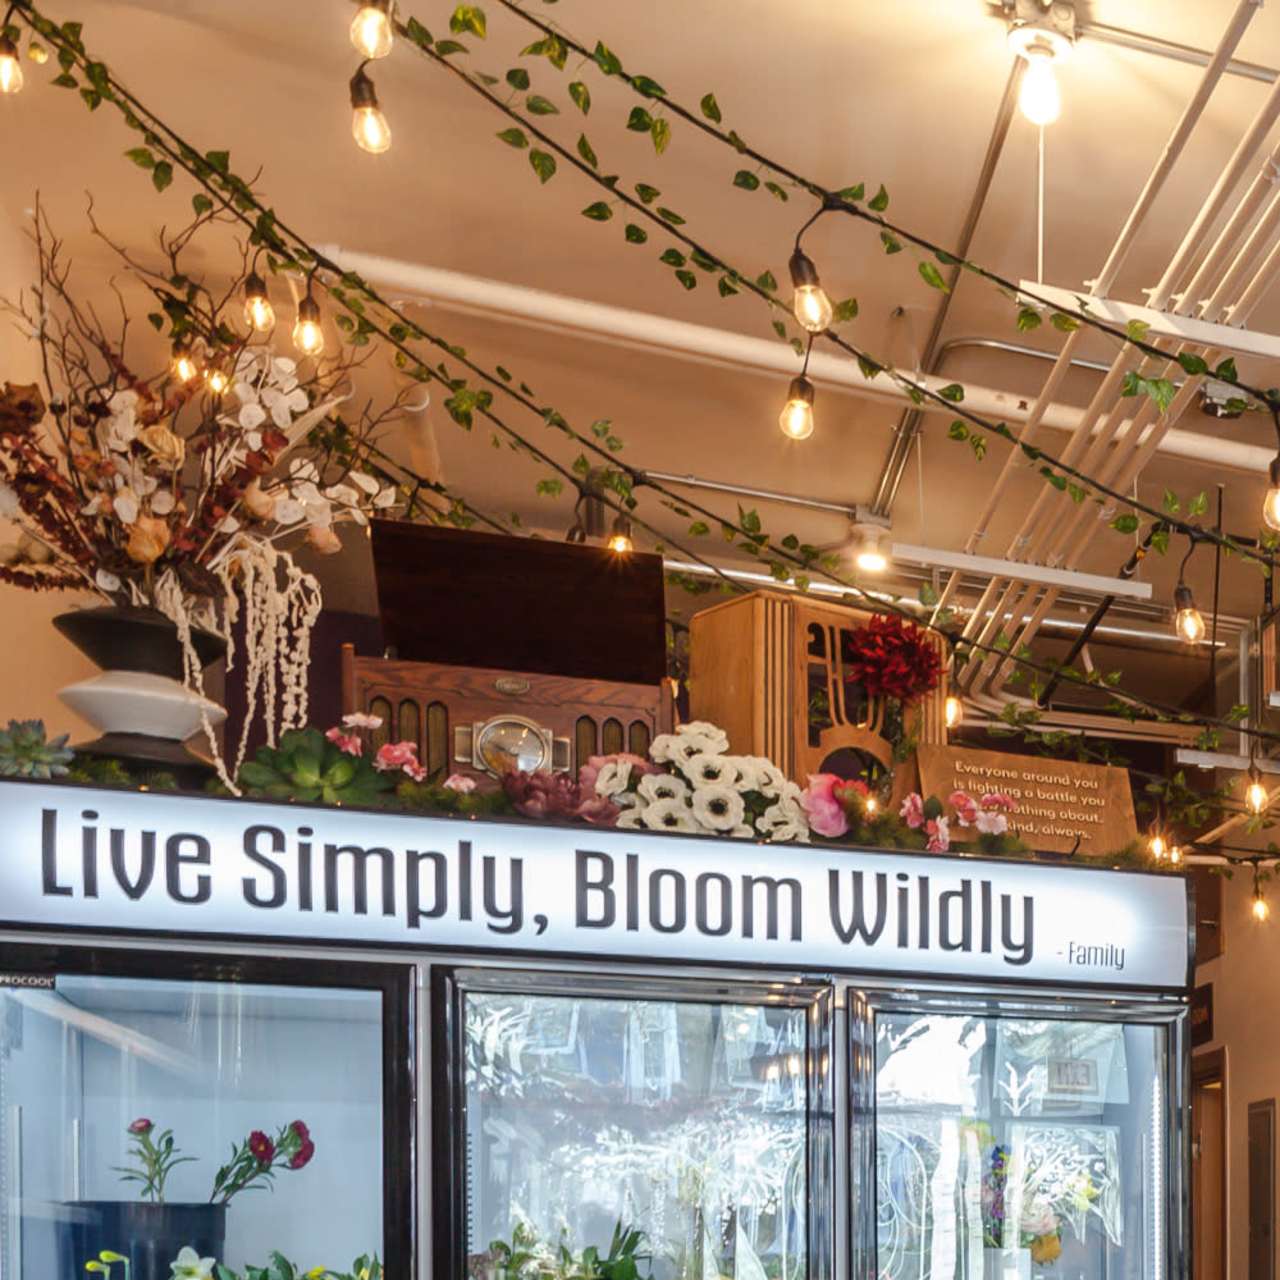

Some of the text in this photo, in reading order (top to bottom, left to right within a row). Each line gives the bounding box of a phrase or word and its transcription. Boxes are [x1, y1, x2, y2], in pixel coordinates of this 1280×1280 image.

[955, 761, 1098, 789] Everyone around you
[953, 778, 1105, 807] is fighting a battle you
[41, 808, 1035, 967] Live Simply, Bloom Wildly
[1069, 941, 1125, 970] Family
